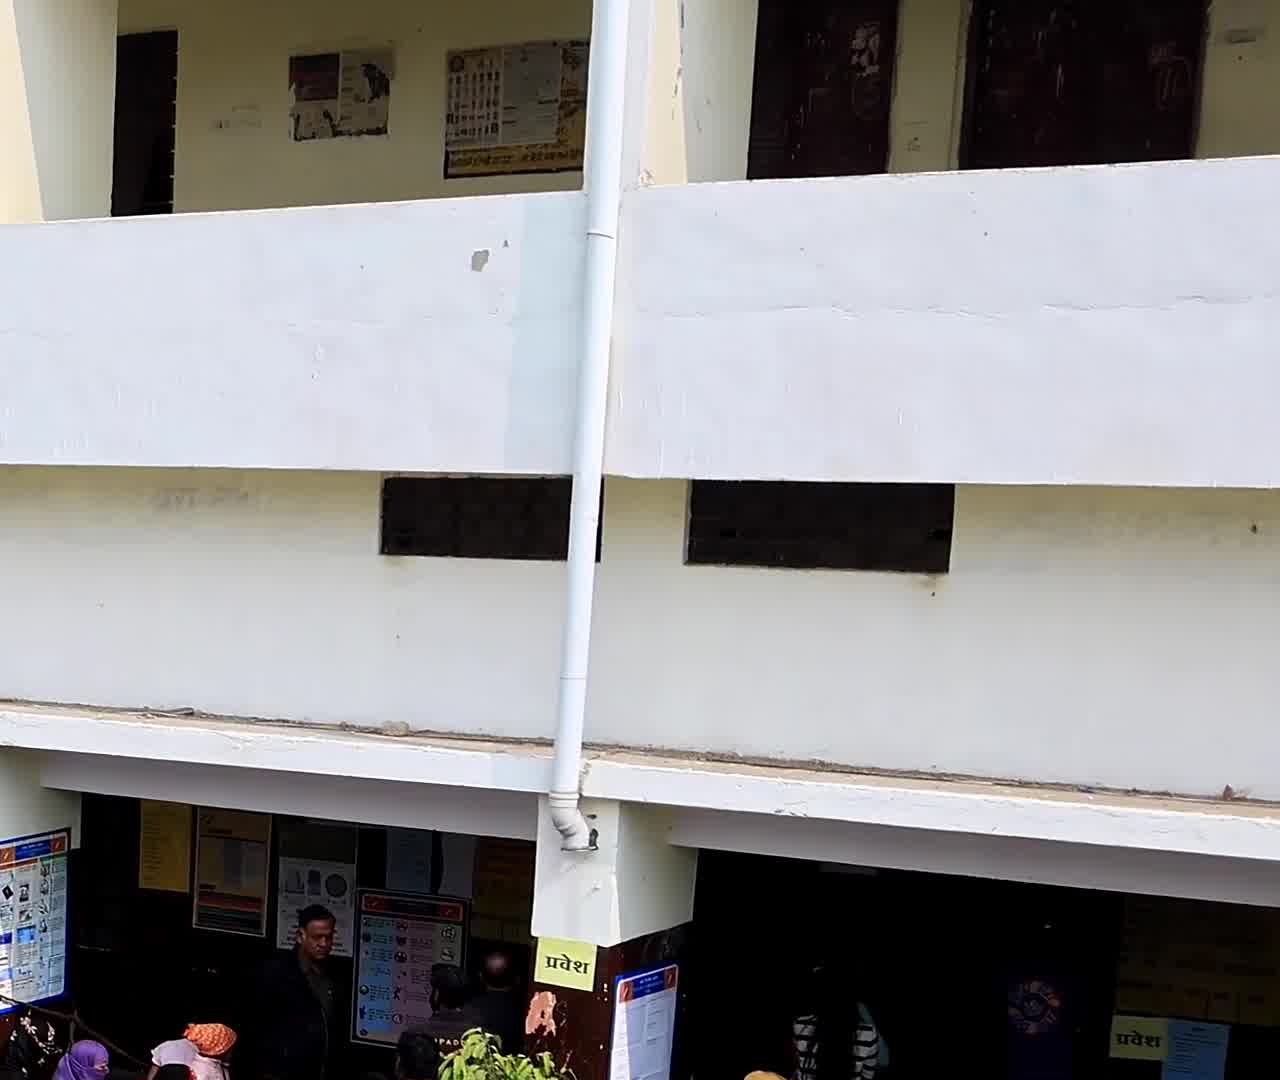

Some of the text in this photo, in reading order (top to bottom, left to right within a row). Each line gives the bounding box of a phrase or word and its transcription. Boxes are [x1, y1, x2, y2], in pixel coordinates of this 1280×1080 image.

[544, 953, 590, 974] प्रवेश
[434, 1037, 464, 1049] PAD
[1115, 1030, 1160, 1048] प्रवेश
